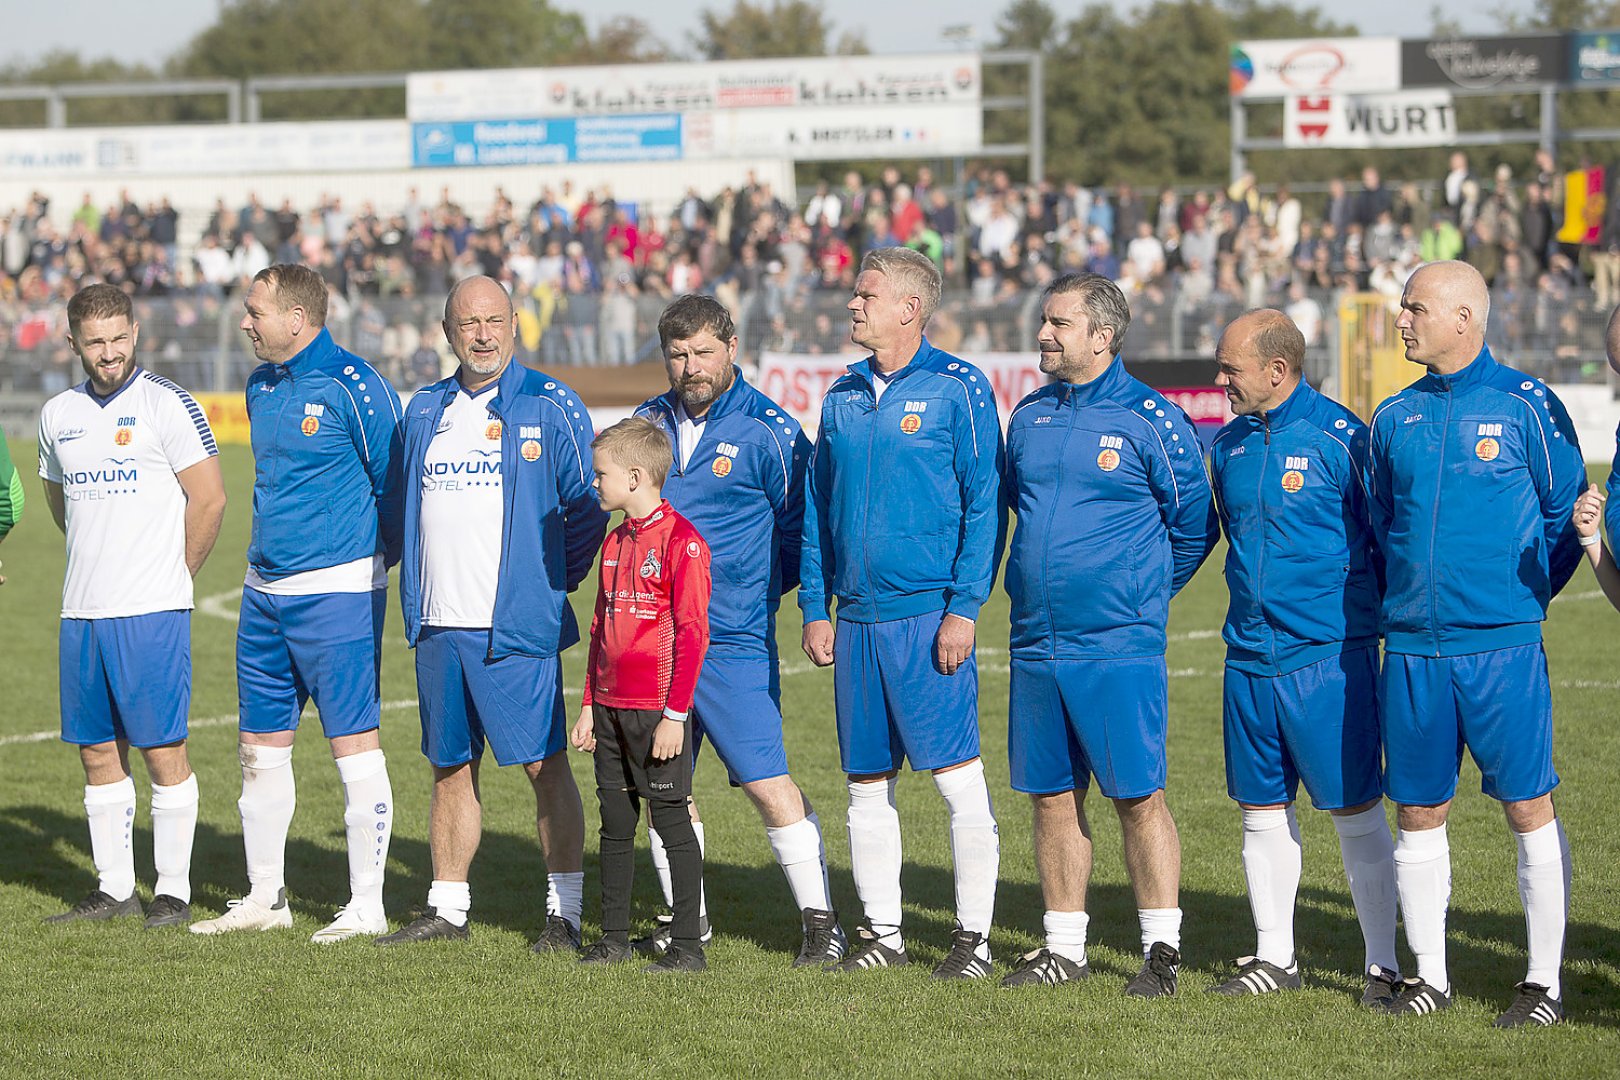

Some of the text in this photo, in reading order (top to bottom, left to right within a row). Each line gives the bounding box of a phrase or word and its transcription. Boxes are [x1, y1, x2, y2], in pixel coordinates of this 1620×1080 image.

[304, 402, 325, 417] DDR
[904, 400, 927, 413] DDR
[117, 417, 136, 427] DDR
[520, 426, 542, 439] DDR
[1478, 423, 1503, 437] DDR
[1100, 435, 1124, 450] DDR
[716, 442, 740, 459] DDR
[424, 461, 502, 476] NOVUM
[1285, 456, 1309, 471] DDR
[63, 469, 137, 486] NOVUM
